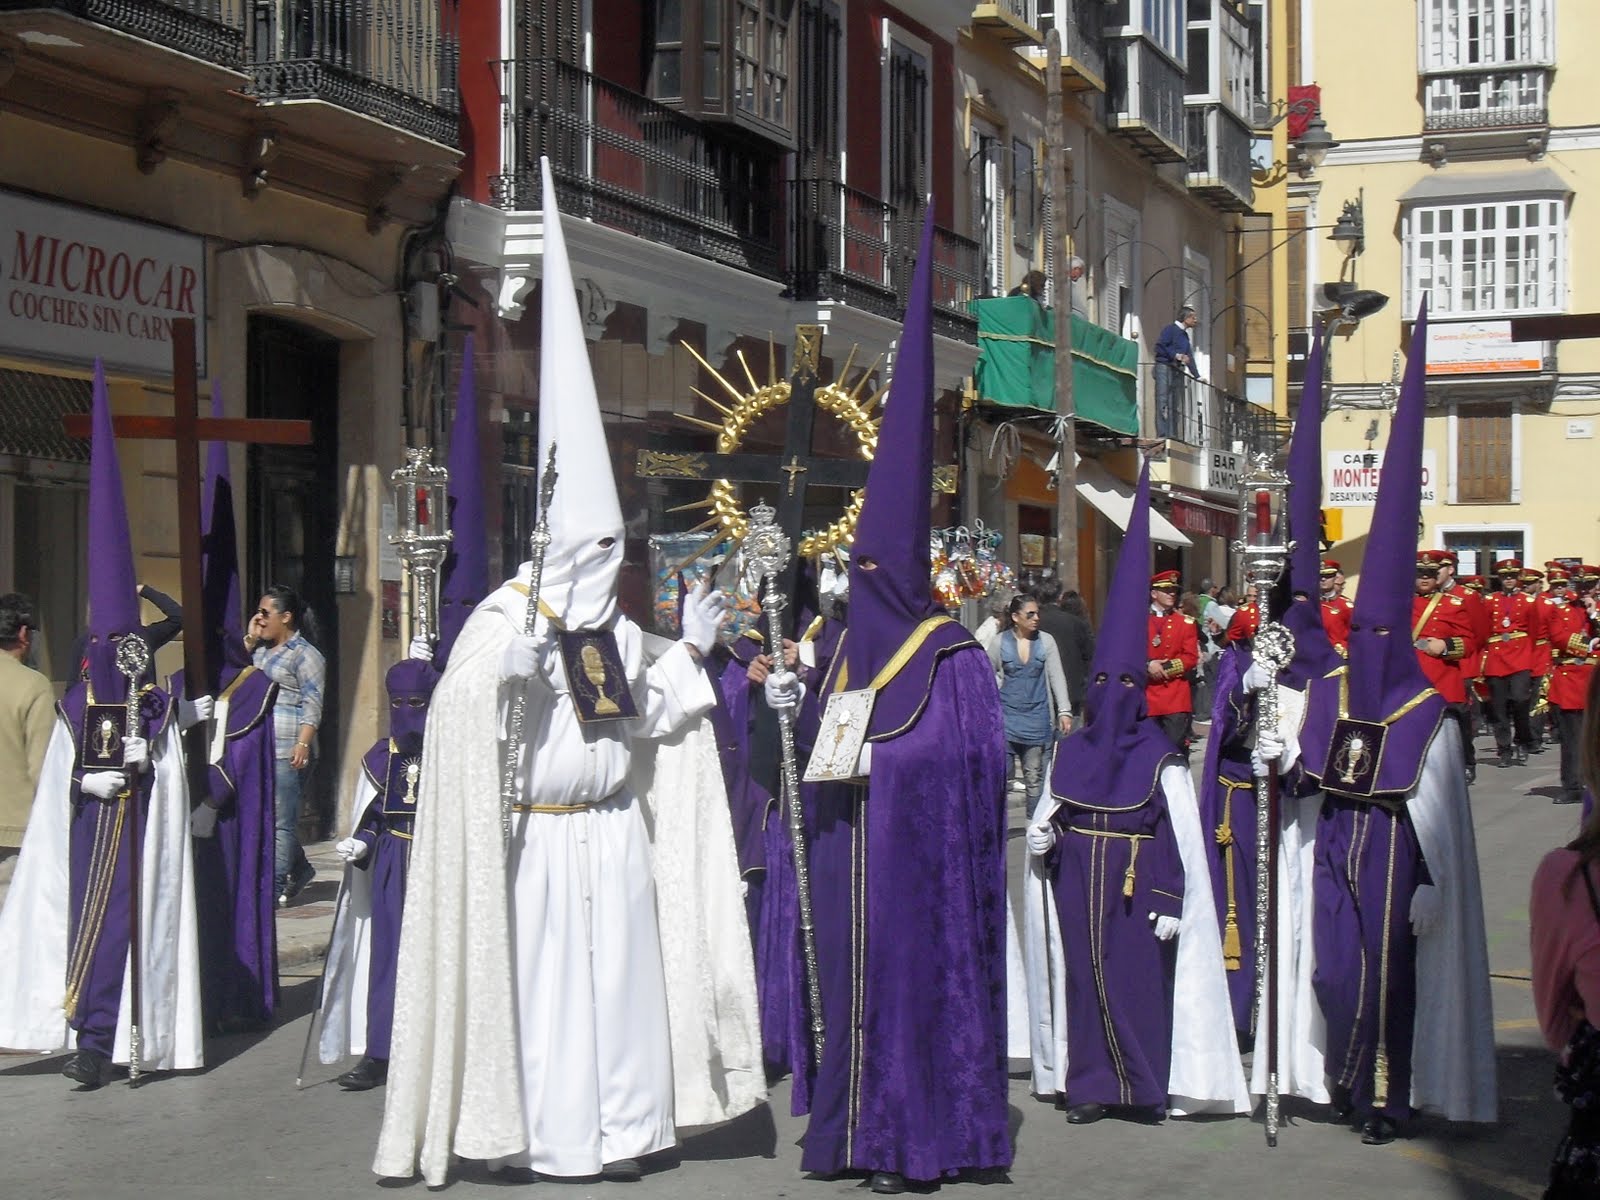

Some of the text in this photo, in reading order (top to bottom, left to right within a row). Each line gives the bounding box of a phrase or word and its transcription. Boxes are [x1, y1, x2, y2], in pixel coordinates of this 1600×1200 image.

[9, 230, 198, 314] MICROCAR
[9, 289, 175, 342] COCHES SIN CARN
[1213, 454, 1236, 471] BAR
[1329, 491, 1378, 502] DESAYUNOS
